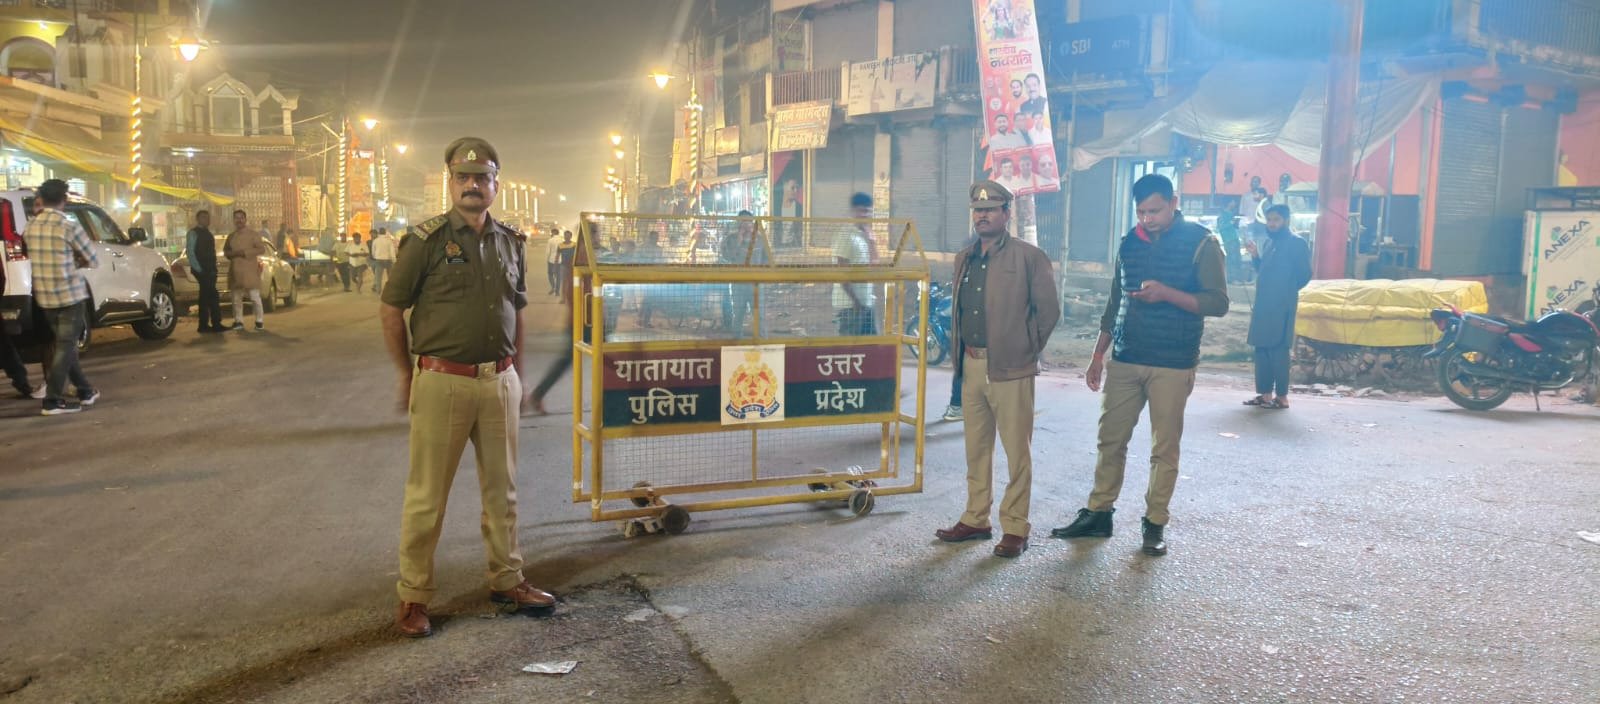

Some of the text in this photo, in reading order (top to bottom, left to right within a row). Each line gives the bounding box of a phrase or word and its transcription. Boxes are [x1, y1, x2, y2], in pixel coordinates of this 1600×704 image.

[1071, 37, 1092, 55] SBI
[1543, 219, 1590, 260] ANEXA
[1540, 279, 1586, 315] ANEXA
[614, 357, 714, 382] यातायात
[816, 353, 866, 376] उत्तर
[628, 387, 698, 424] पुलिस
[814, 381, 866, 412] प्रदेश
